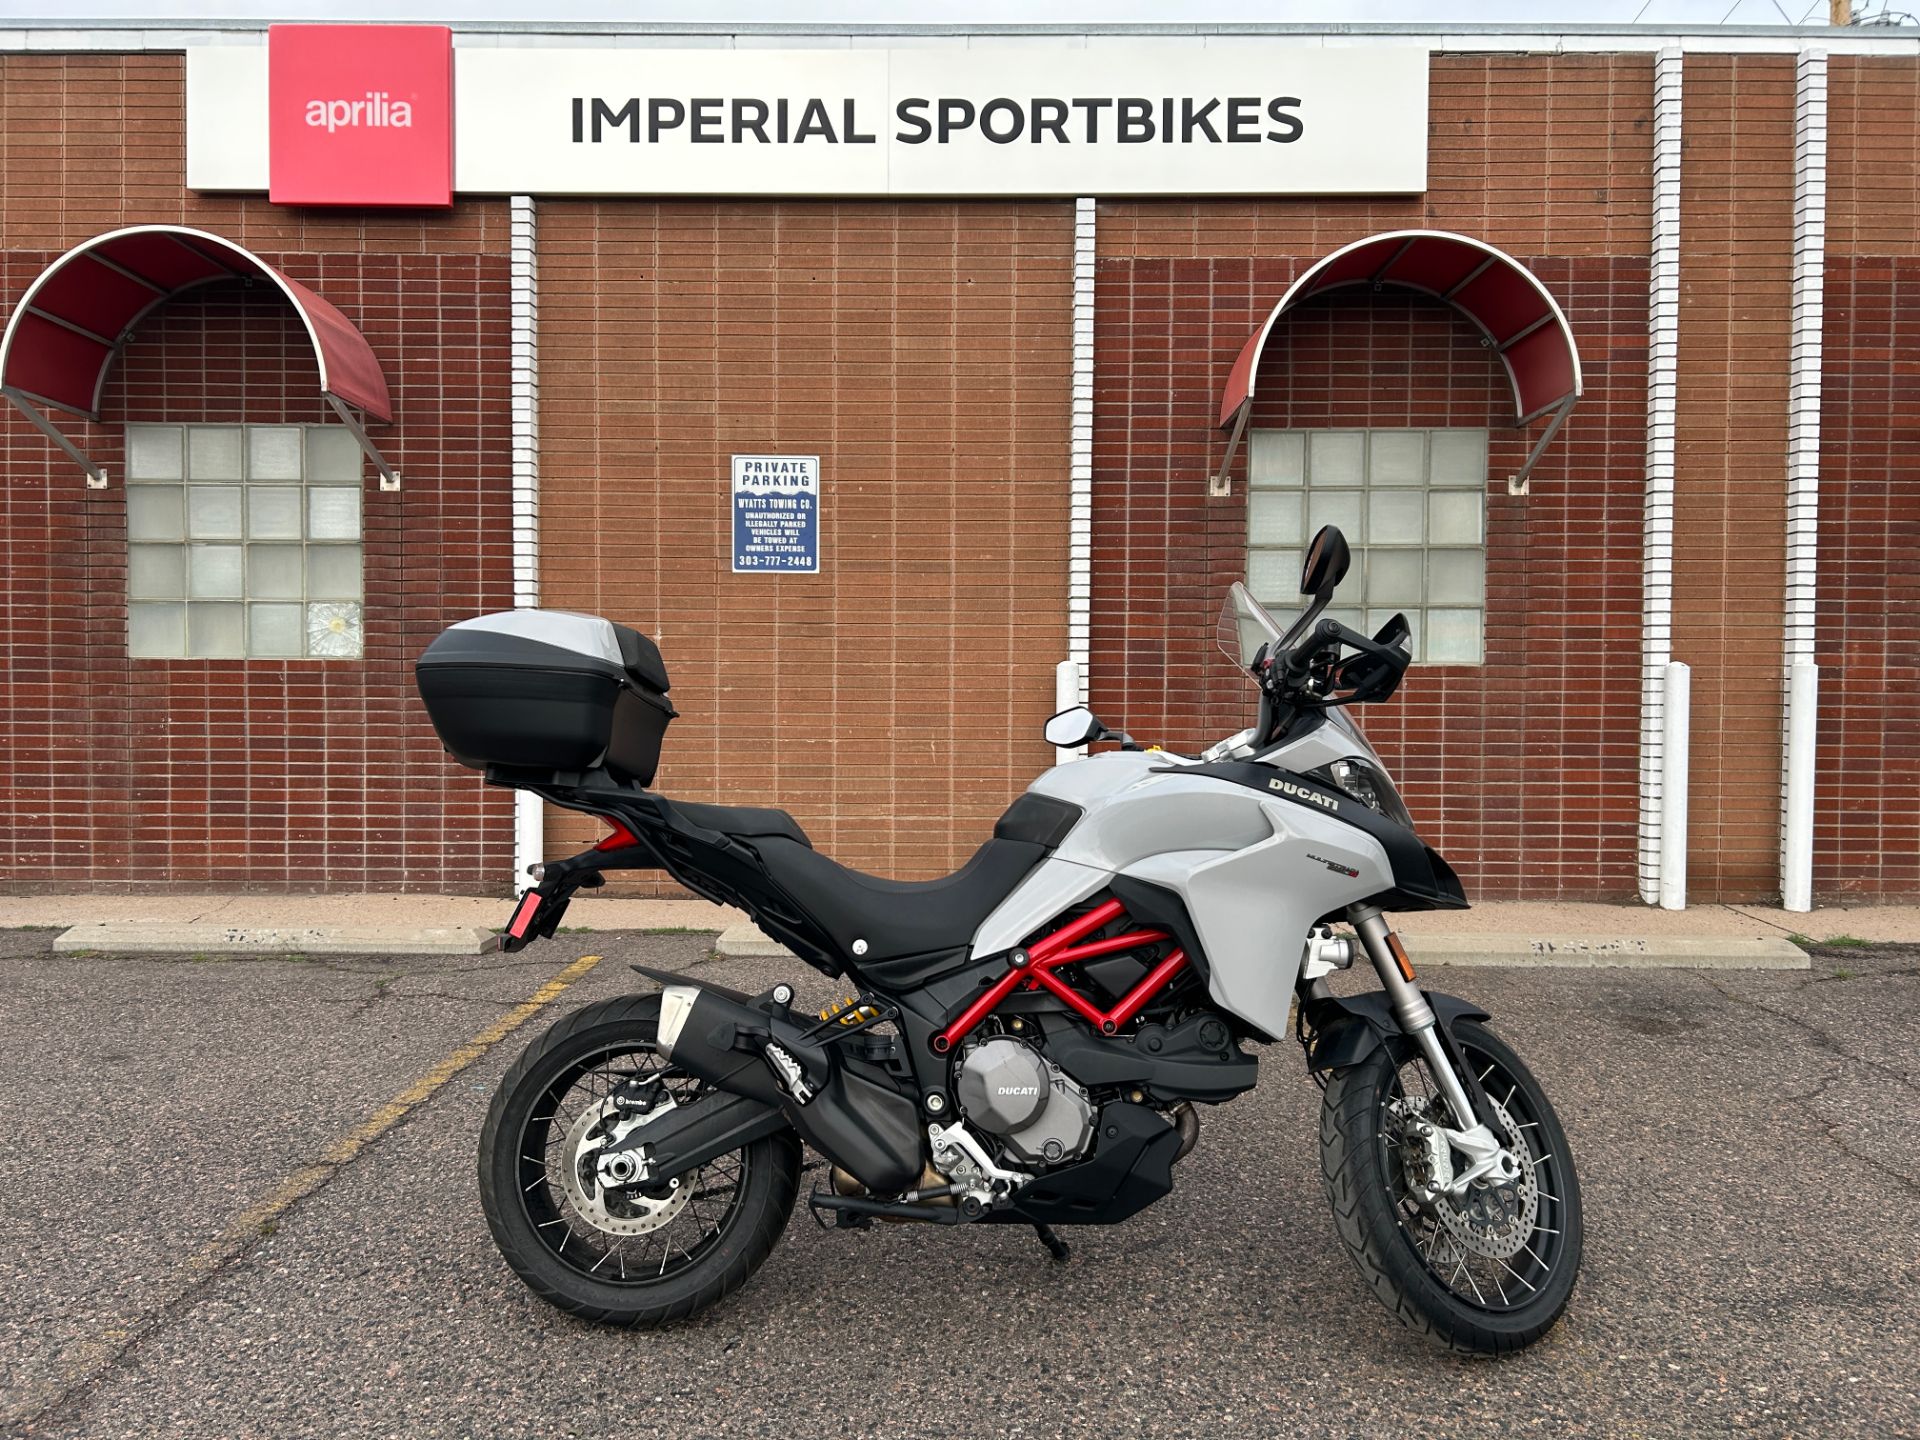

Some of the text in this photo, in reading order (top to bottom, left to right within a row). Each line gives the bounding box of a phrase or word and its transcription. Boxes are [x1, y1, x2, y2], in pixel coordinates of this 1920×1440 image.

[305, 91, 413, 133] aprilia
[572, 96, 1304, 145] IMPERIAL SPORTBIKES
[744, 462, 807, 473] PRIVATE
[742, 475, 809, 486] PARKING
[738, 498, 767, 509] WYATTS
[769, 499, 797, 510] TOWING
[745, 512, 807, 520] UNAUTHORIZED OR
[745, 520, 806, 529] ILLEGALLY PARKED
[751, 528, 782, 536] VEHICLES
[753, 536, 762, 544] BE
[763, 537, 787, 545] TOWED
[775, 545, 806, 553] EXPENSE
[1268, 778, 1339, 811] DUCATI
[997, 1087, 1038, 1096] DUCATI
